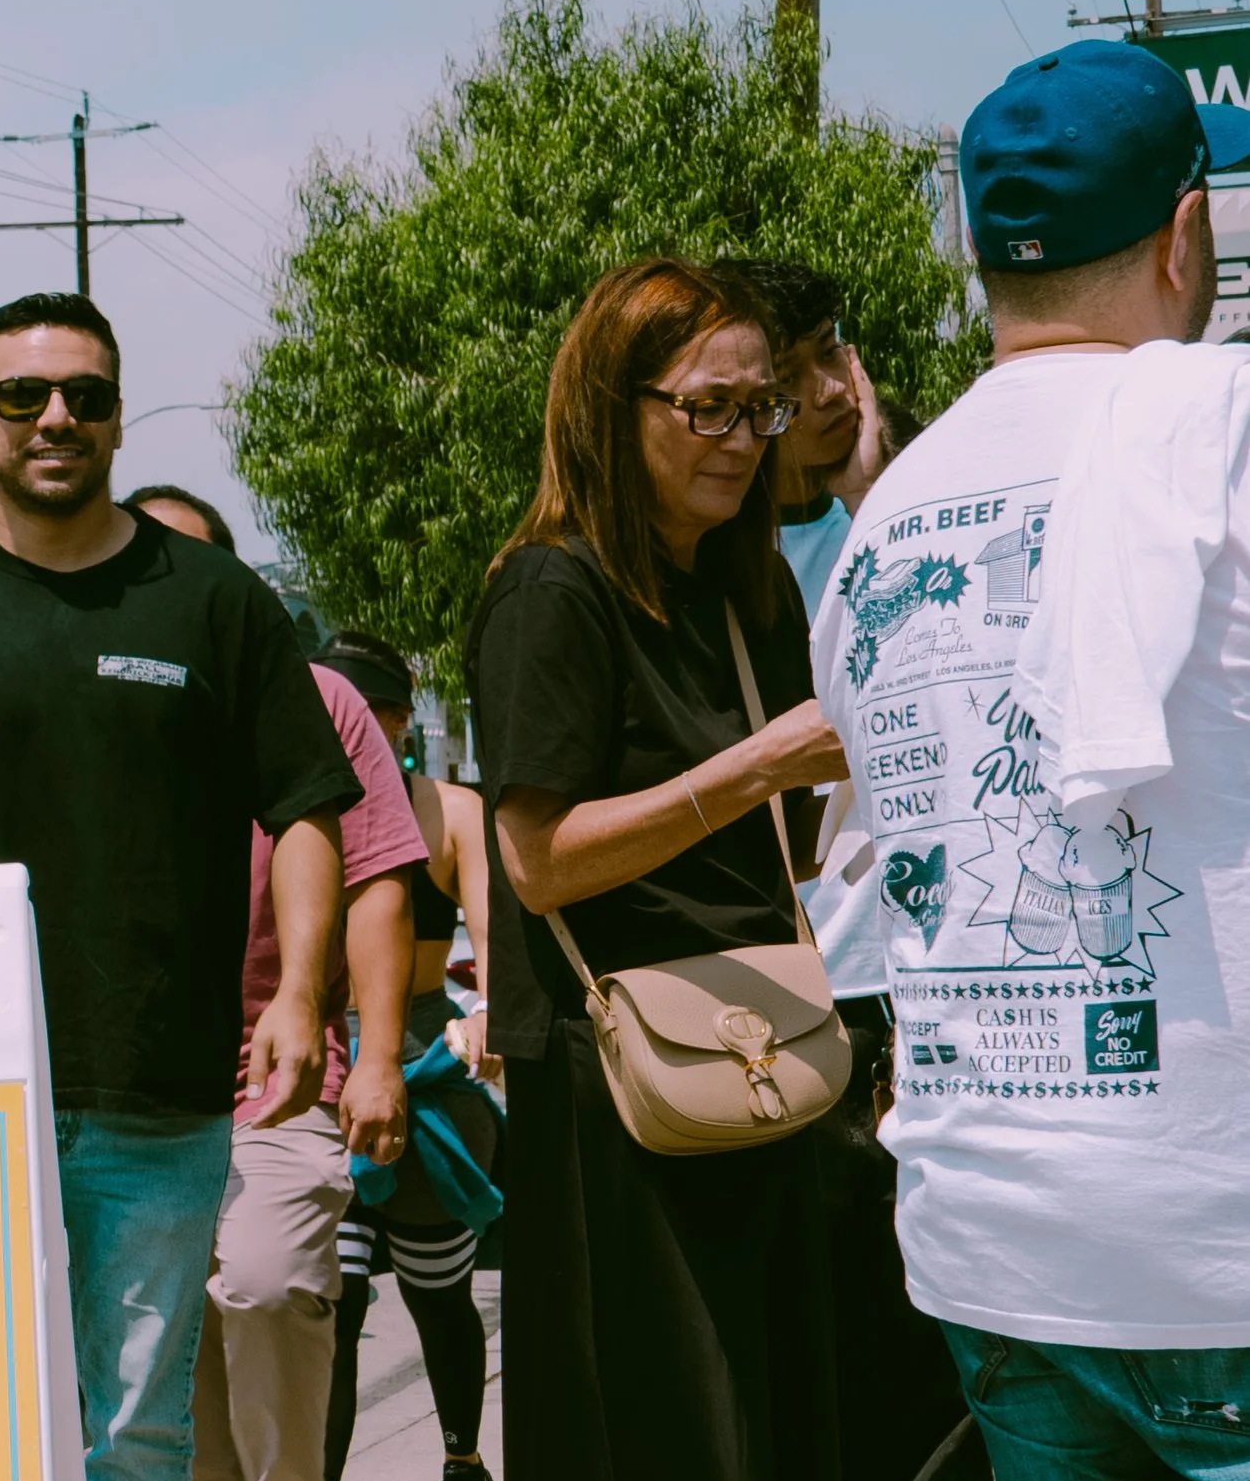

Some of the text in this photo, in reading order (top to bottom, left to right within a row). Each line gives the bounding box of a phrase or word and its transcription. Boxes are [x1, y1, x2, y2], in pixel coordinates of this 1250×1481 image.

[887, 498, 1007, 545] MR. BEEF
[905, 617, 961, 645] Comes To
[983, 612, 1030, 630] ON 3RD
[894, 647, 918, 668] Los
[919, 633, 973, 663] Angeles
[936, 666, 951, 676] LOS
[871, 703, 918, 735] ONE
[865, 741, 947, 782] EEKEND
[880, 790, 936, 821] ONLY
[1039, 1008, 1057, 1027] IS
[1095, 1010, 1143, 1041] Sorry
[974, 1031, 1060, 1050] ALWAYS
[1107, 1037, 1131, 1051] NO
[968, 1054, 1071, 1073] ACCEPTED
[1095, 1050, 1148, 1067] CREDIT
